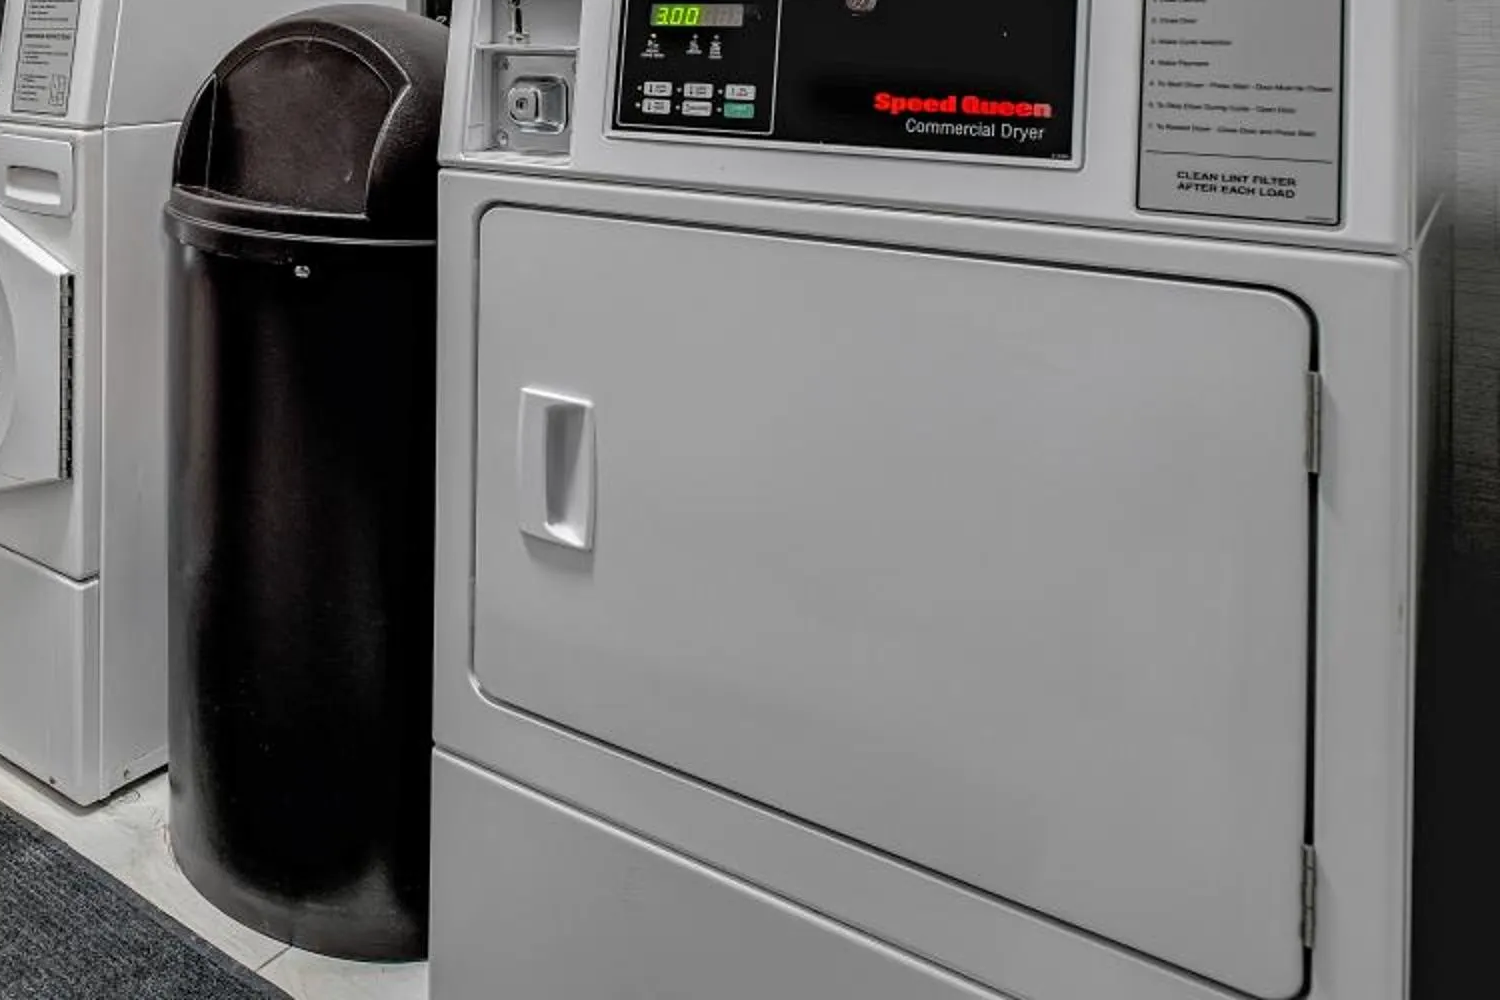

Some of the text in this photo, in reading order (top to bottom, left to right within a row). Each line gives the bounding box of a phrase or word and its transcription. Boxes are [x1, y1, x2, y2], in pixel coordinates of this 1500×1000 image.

[873, 91, 1053, 118] Speed Queen
[904, 117, 1045, 143] Commercial Dryer
[1176, 171, 1297, 187] CLEAN LINT FILTER
[1176, 182, 1296, 199] AFTER EACH LOAD
